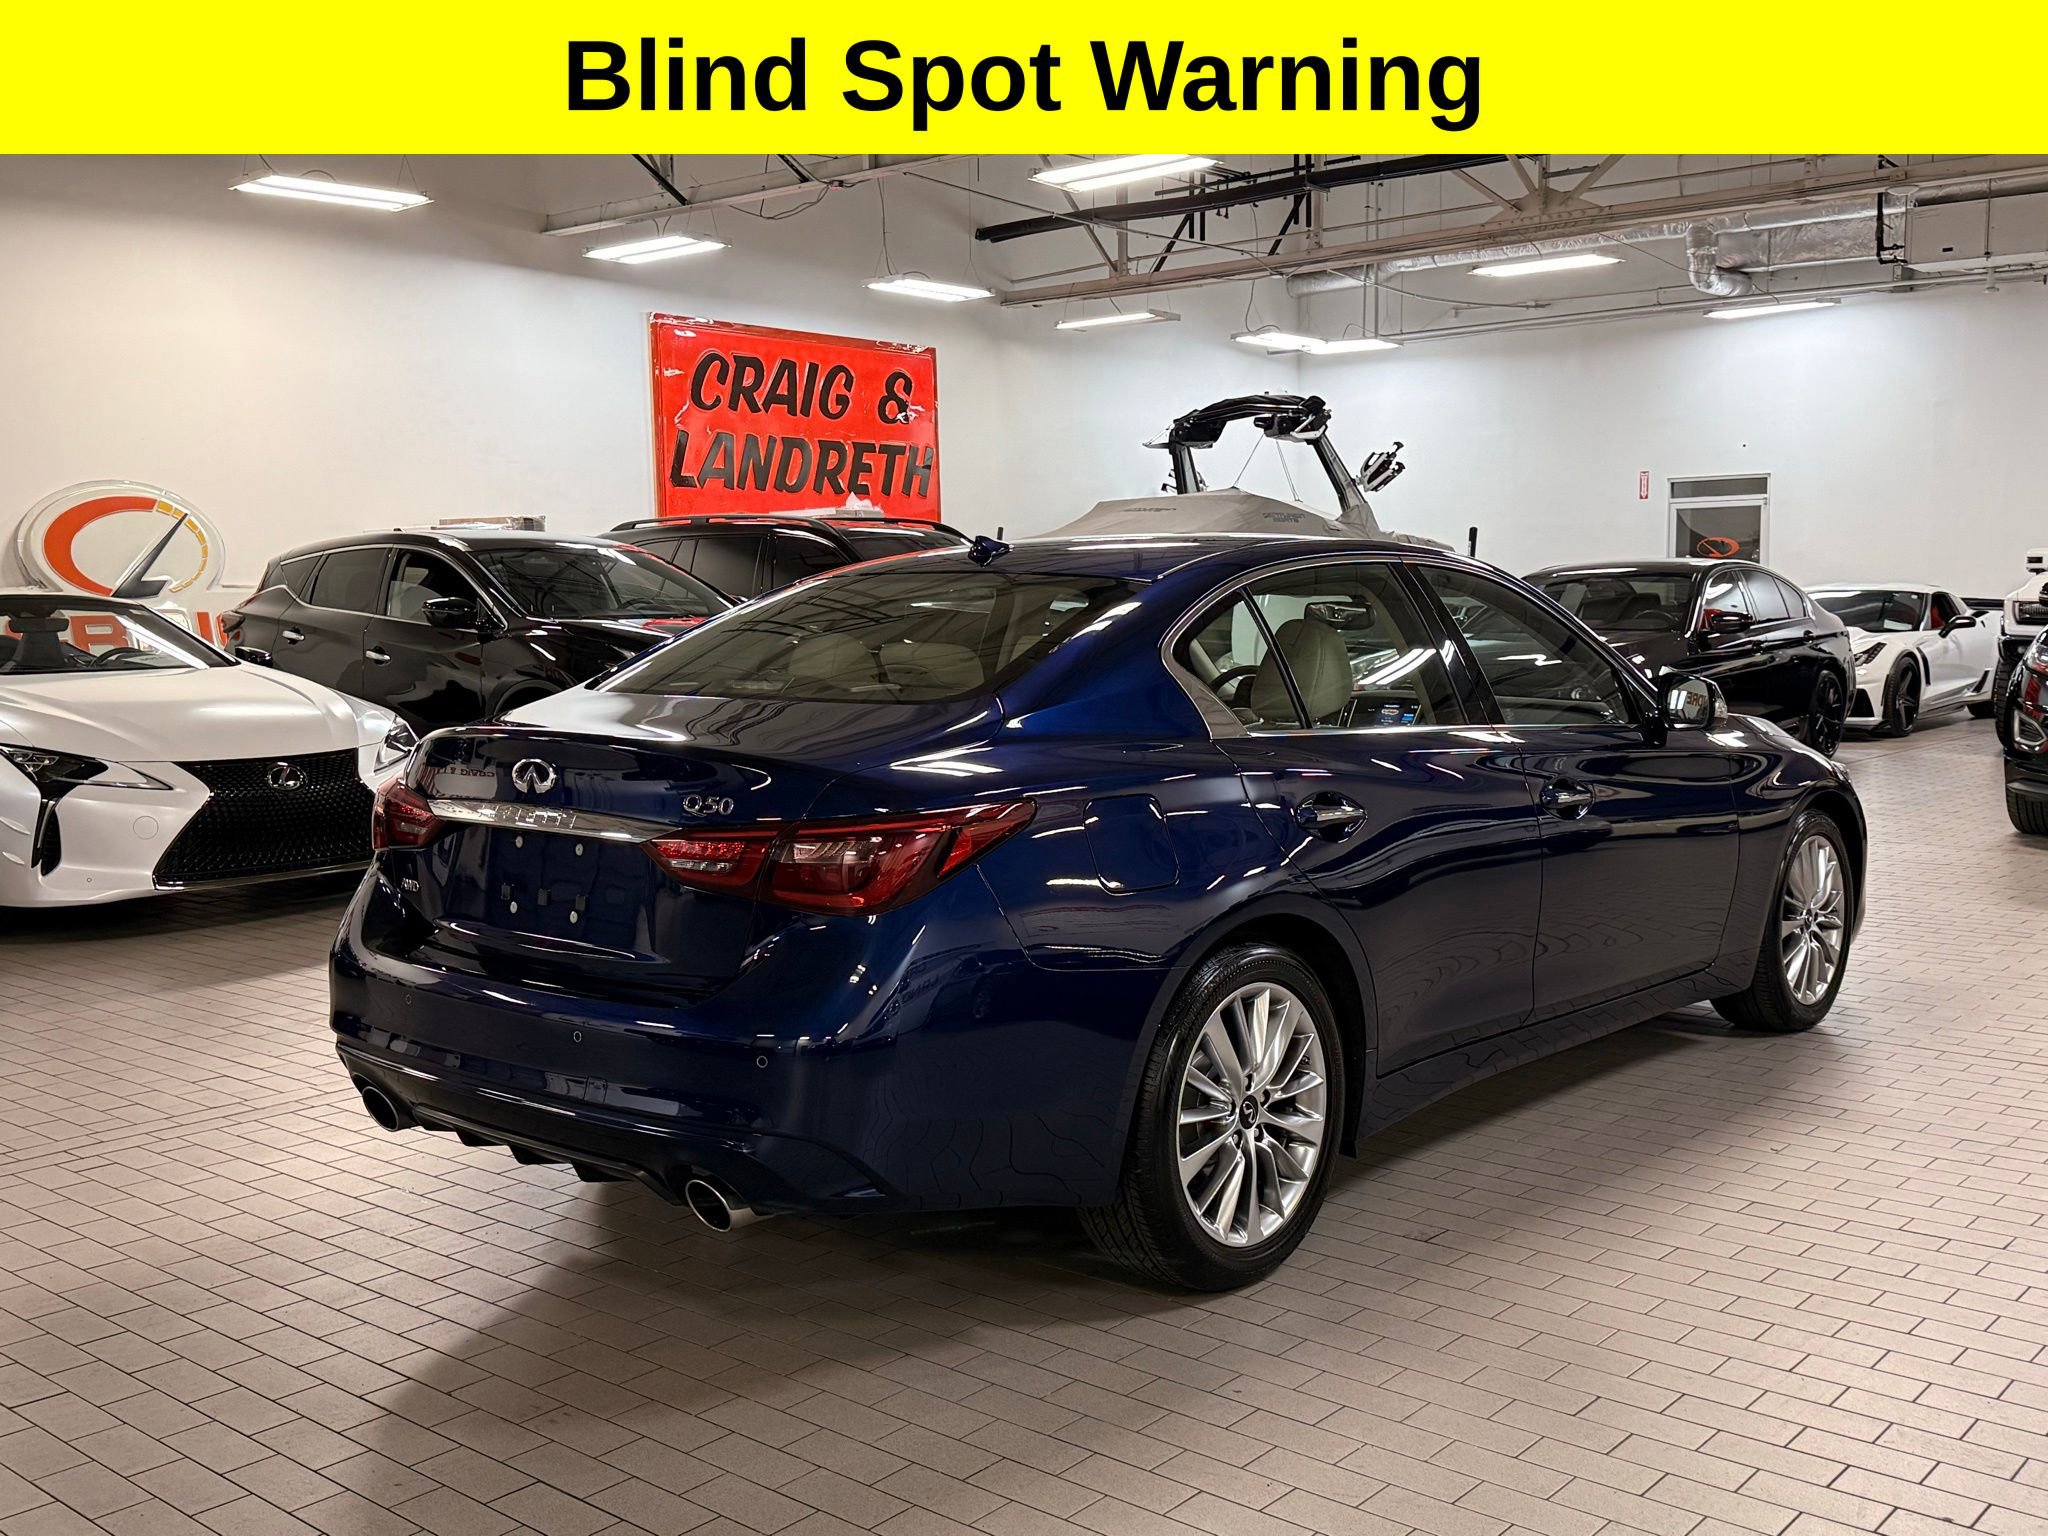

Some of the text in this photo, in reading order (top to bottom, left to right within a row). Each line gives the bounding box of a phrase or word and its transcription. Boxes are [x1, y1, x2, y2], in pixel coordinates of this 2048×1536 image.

[690, 351, 913, 424] CRAIG &
[669, 429, 935, 498] LANDRETH
[683, 794, 734, 817] Q50
